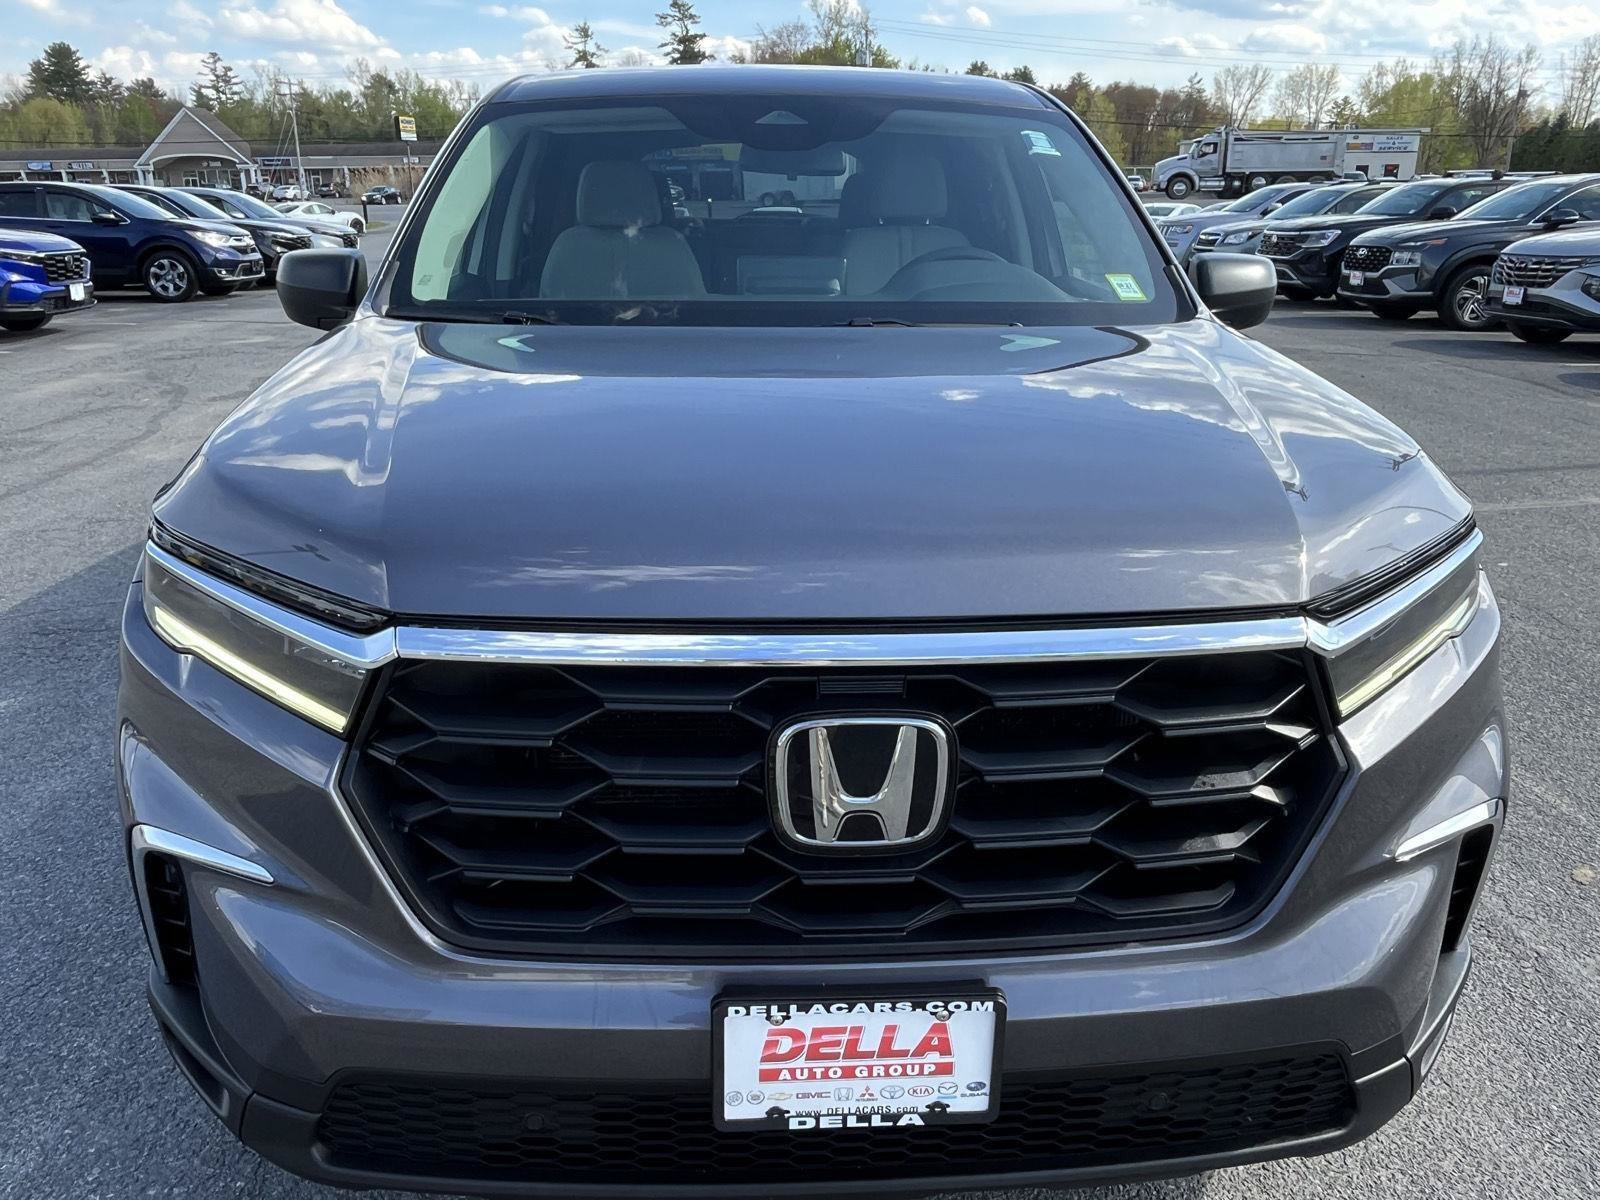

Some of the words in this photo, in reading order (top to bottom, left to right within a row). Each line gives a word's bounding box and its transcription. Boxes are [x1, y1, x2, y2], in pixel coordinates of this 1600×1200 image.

[727, 1001, 994, 1016] DELLACARS.COM
[760, 1022, 953, 1063] DELLA
[778, 1066, 842, 1081] AUTO
[855, 1064, 937, 1078] GROUP
[912, 1087, 931, 1095] KIA
[789, 1113, 925, 1130] DELLA
